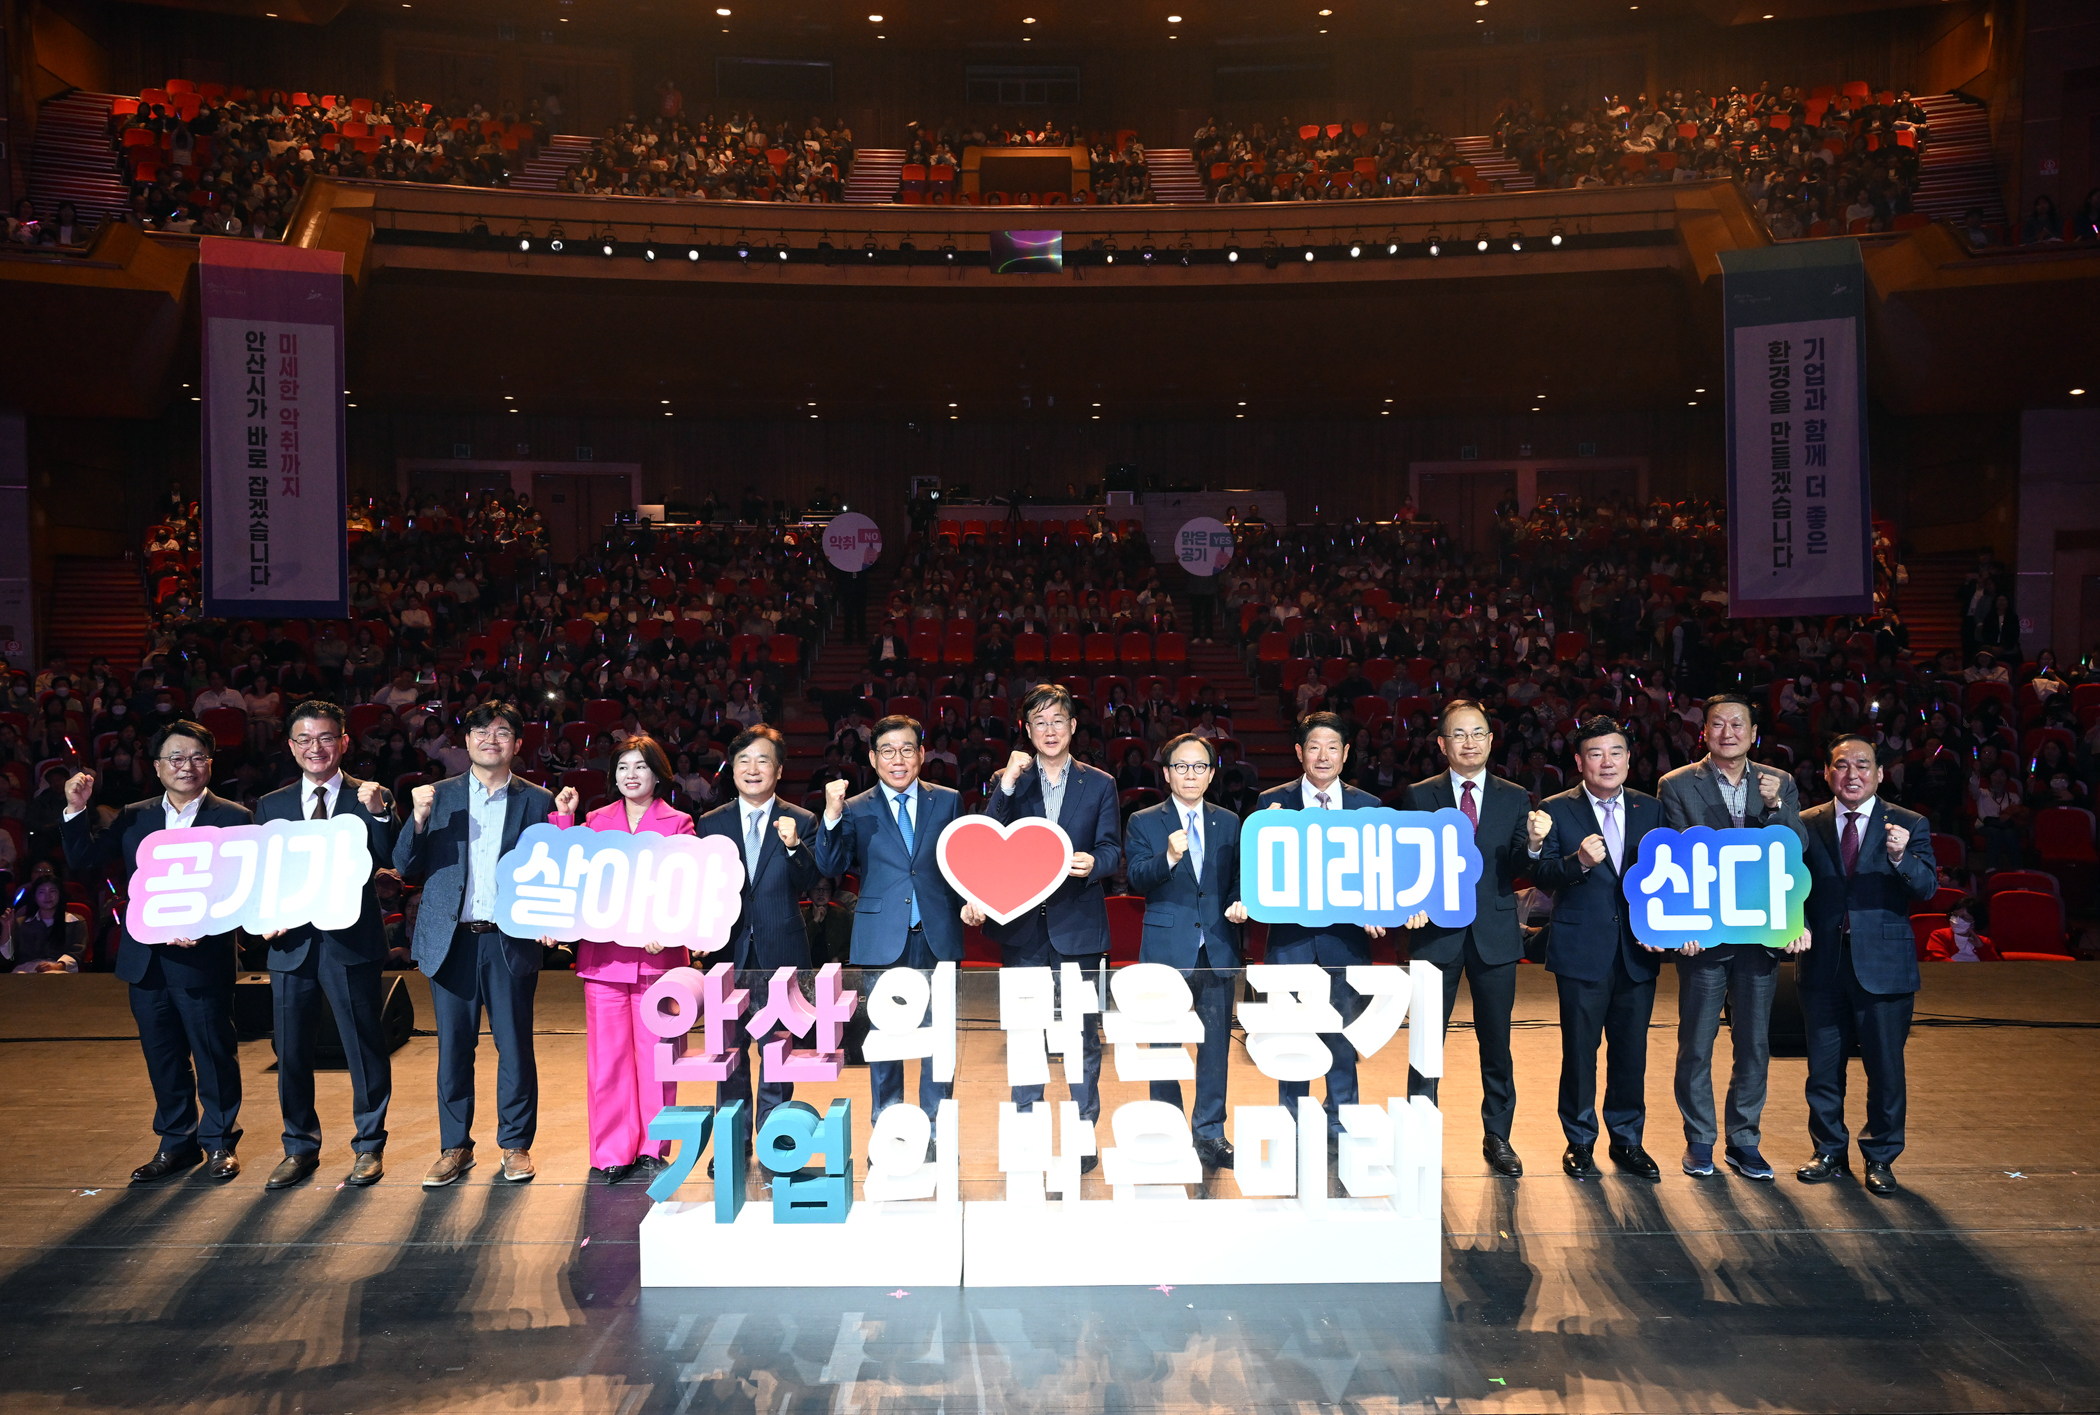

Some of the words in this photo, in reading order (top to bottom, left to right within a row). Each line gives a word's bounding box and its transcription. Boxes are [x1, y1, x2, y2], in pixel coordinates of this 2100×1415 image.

[245, 330, 268, 420] 안산시가
[278, 333, 300, 401] 미세한
[1767, 340, 1792, 415] 환경을
[1803, 337, 1828, 411] 기업과
[247, 426, 268, 469] 바로
[279, 407, 301, 498] 악취까지
[1804, 418, 1828, 467] 함께
[1770, 421, 1794, 577] 만들겠습니다.
[1806, 475, 1827, 498] 더
[248, 476, 271, 593] 잡겠습니다.
[829, 535, 856, 550] 악취
[864, 532, 879, 541] NO
[1181, 530, 1207, 546] 맑은
[1181, 547, 1207, 562] 공기
[1213, 536, 1232, 545] YES
[1806, 505, 1829, 555] 좋은
[142, 829, 357, 928] 공기가
[510, 841, 729, 938] 살아야
[1257, 823, 1467, 911] 미래가
[1640, 841, 1795, 931] 산다
[640, 961, 957, 1083] 안산의
[1237, 960, 1444, 1082] 공기
[645, 1098, 959, 1225] 기업의
[1233, 1096, 1443, 1221] 미래
